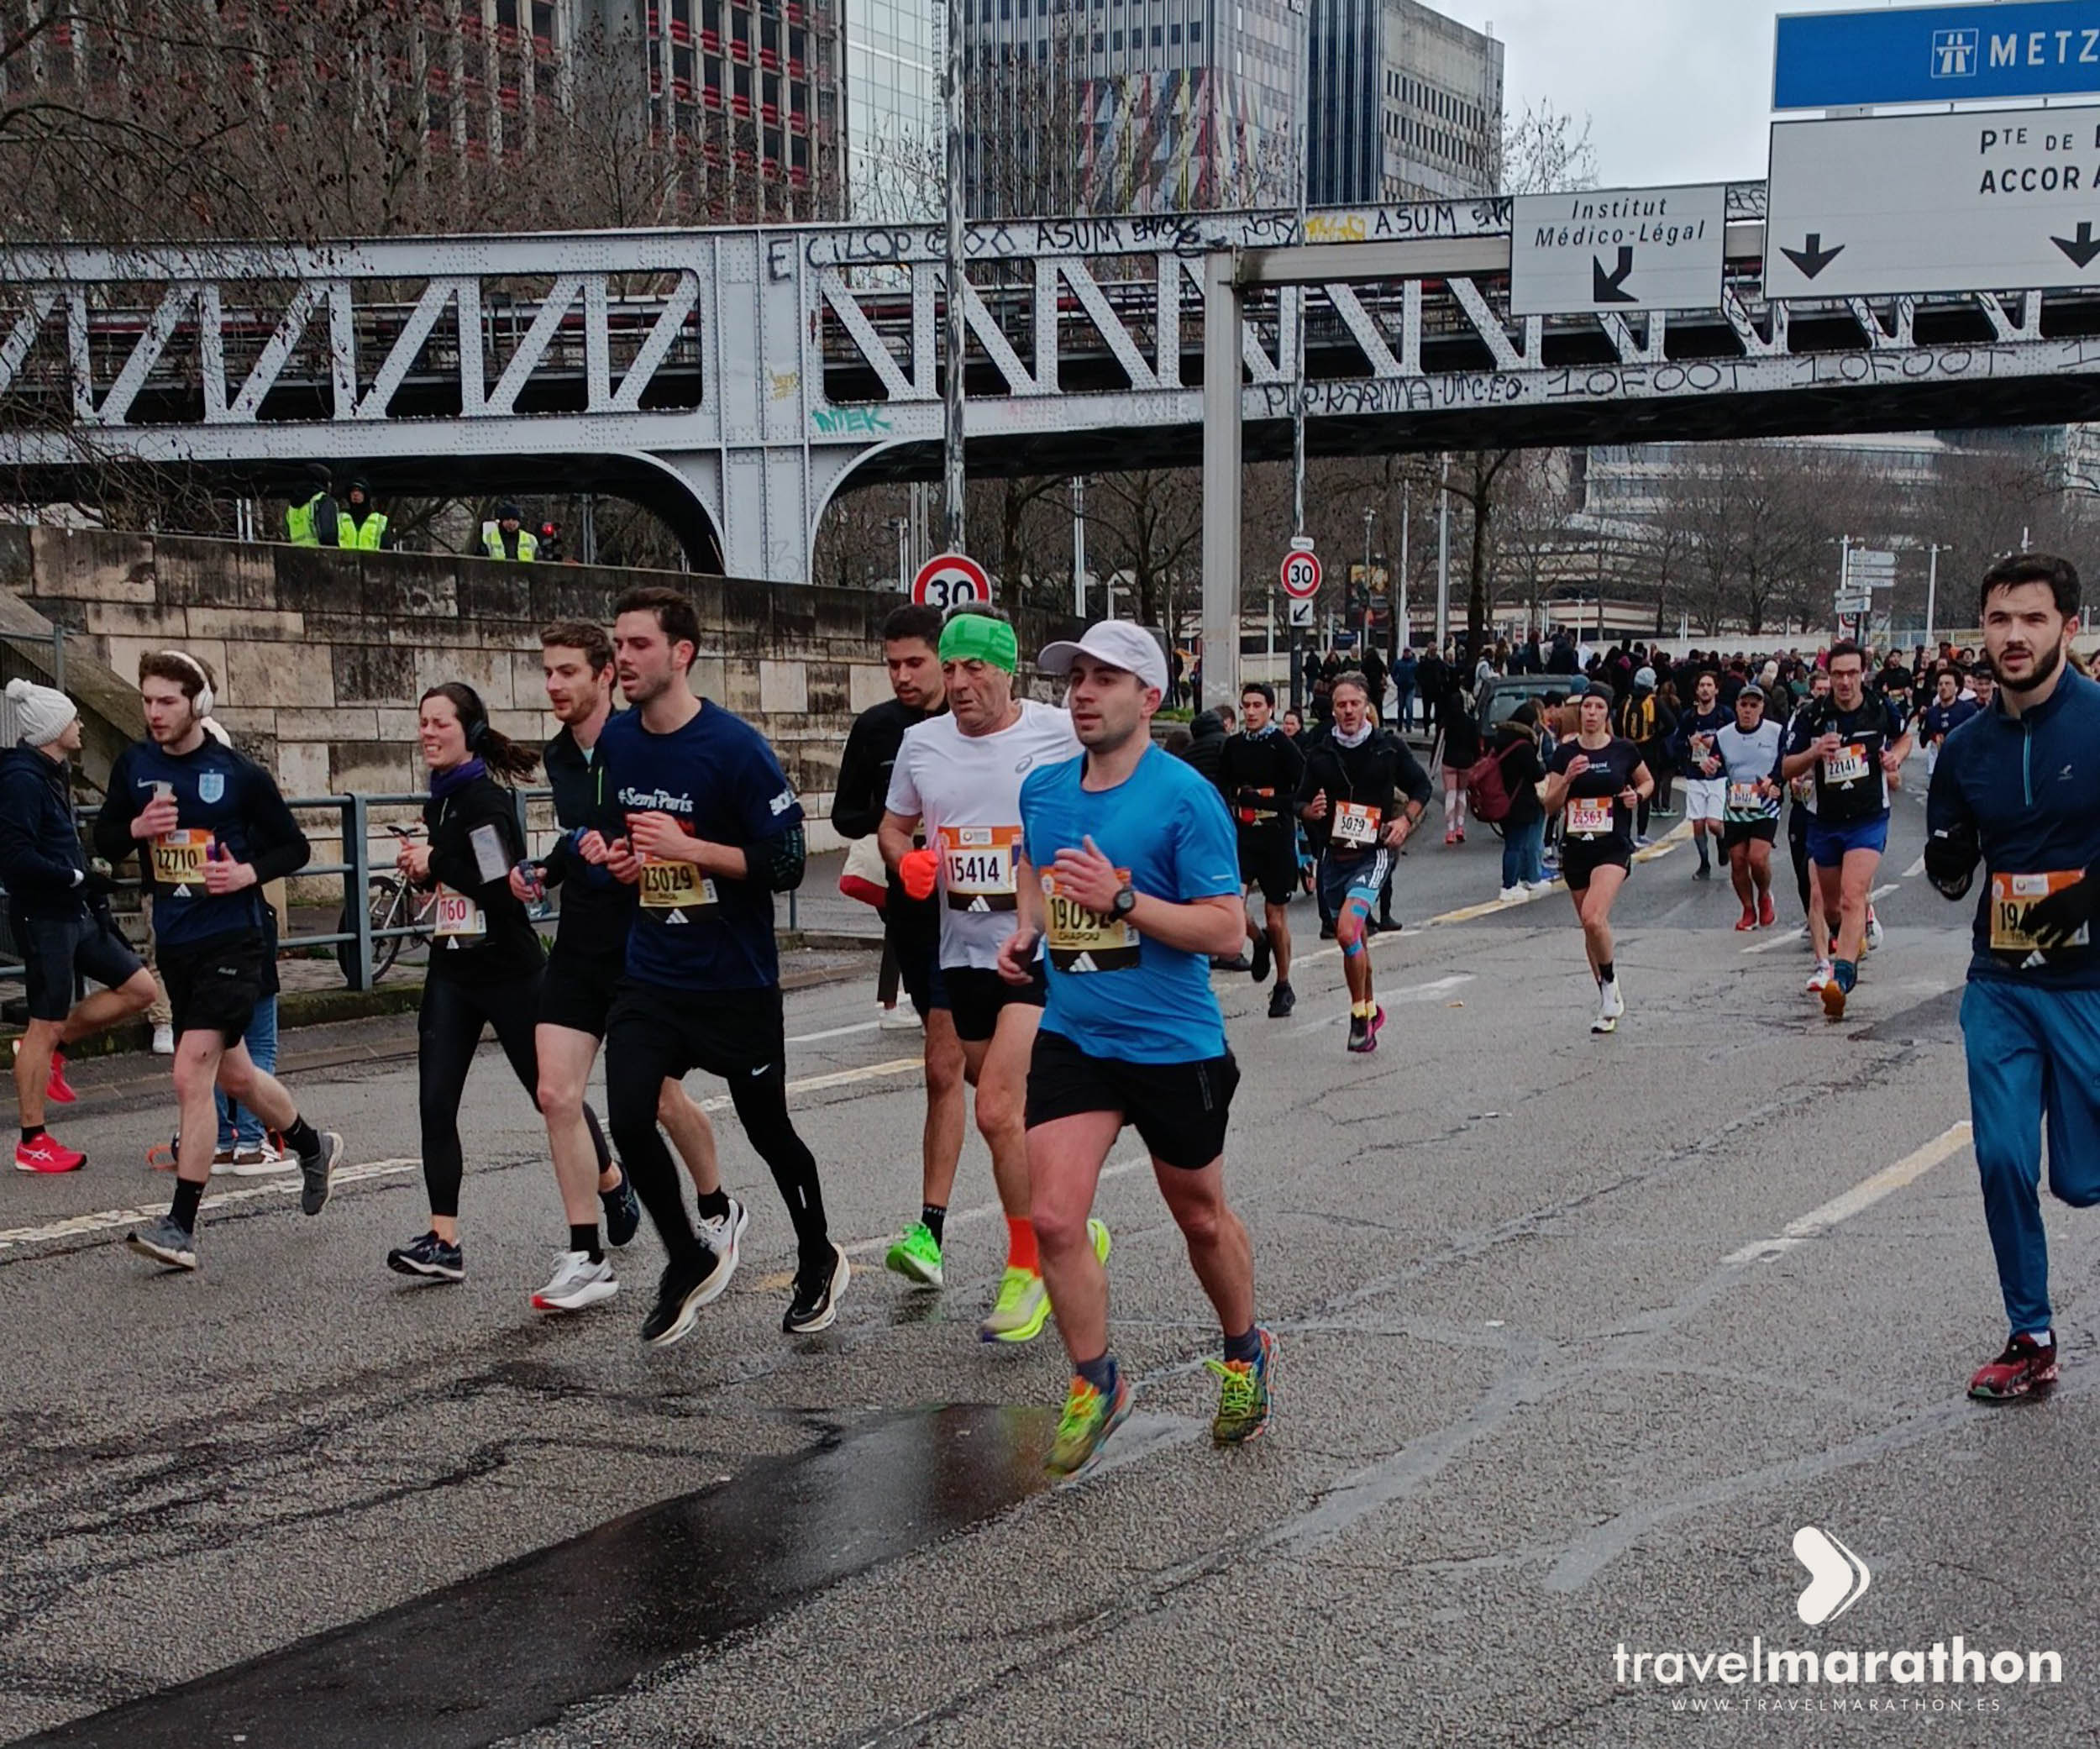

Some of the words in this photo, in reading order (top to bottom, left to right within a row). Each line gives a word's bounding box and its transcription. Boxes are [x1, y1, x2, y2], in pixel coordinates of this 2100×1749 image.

[1990, 28, 2100, 68] METZ
[2045, 134, 2074, 151] DE
[1979, 165, 2081, 195] ACCOR
[1375, 205, 1458, 235] ASUM
[1571, 197, 1667, 221] Institut
[1036, 219, 1123, 251] ASUM
[1535, 219, 1705, 248] Médico-Légal
[1291, 565, 1314, 584] 30
[930, 579, 975, 612] 30
[155, 848, 197, 870] 22710
[948, 856, 1000, 883] 15414
[643, 865, 693, 892] 23029
